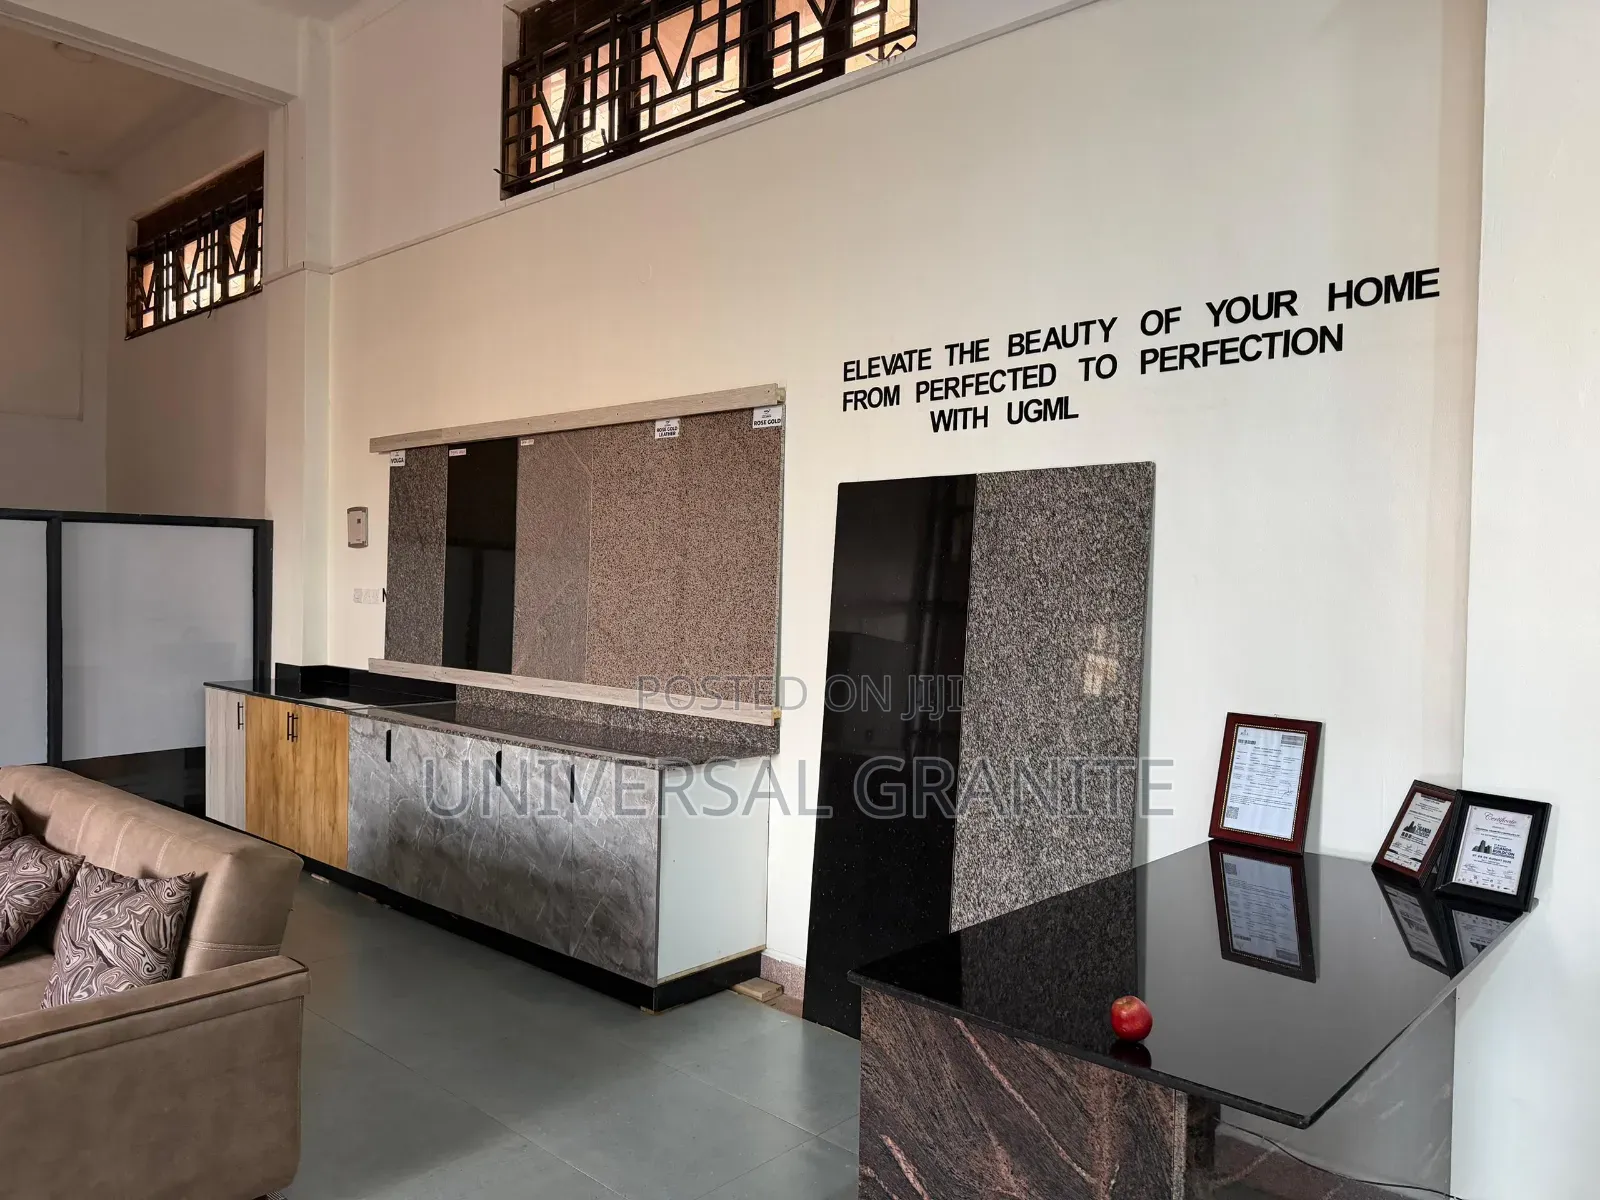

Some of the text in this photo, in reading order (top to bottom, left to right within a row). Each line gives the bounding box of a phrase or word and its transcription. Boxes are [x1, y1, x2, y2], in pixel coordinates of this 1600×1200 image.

[843, 267, 1440, 383] ELEVATE THE BEAUTY OF YOUR HOME
[842, 323, 1344, 412] FROM PERFECTED TO PERFECTION
[929, 395, 1080, 433] WITH UGML
[390, 456, 405, 464] VOLGA
[1484, 811, 1517, 824] Certificate
